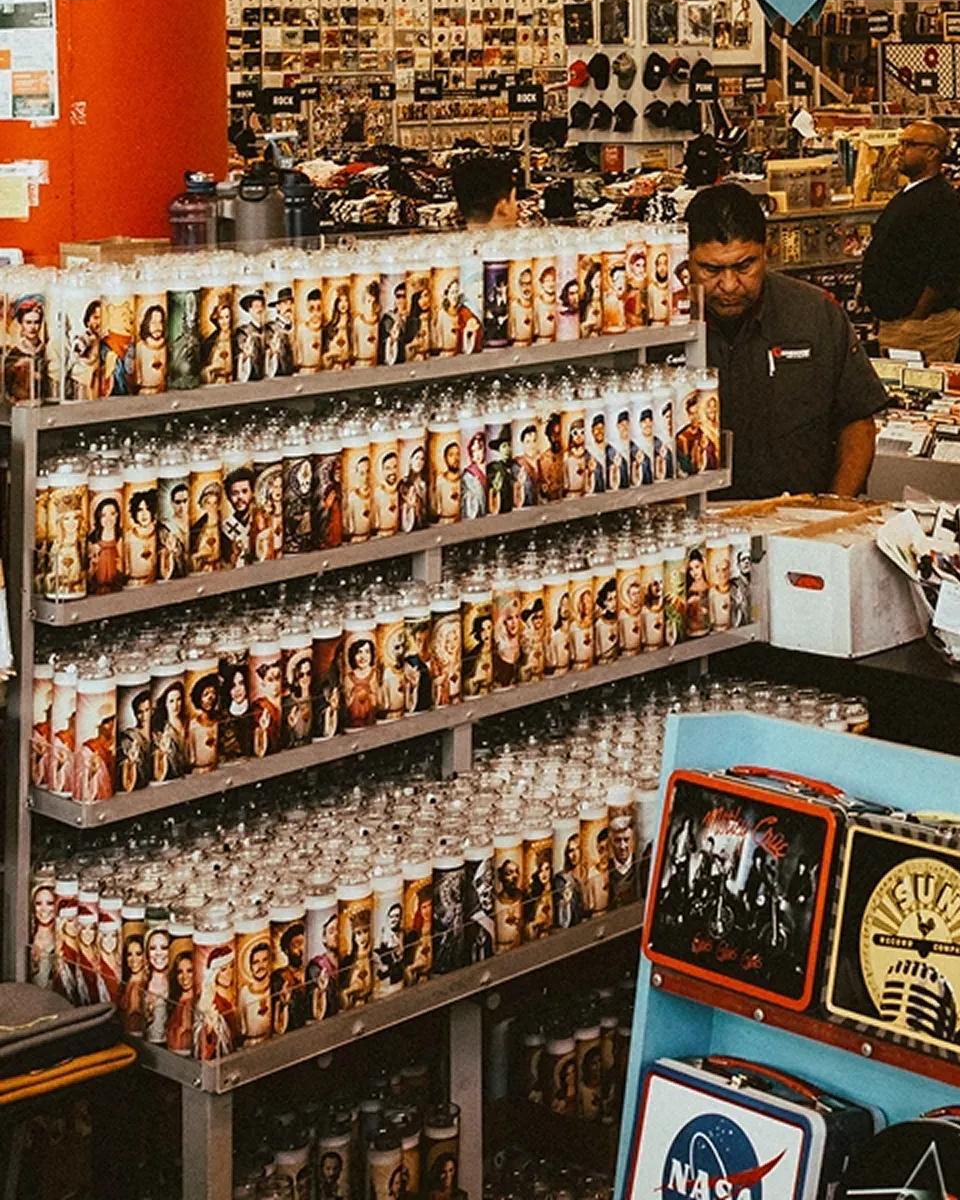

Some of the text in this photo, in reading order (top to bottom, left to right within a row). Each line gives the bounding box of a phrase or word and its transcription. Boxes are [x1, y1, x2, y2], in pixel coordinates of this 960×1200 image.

[272, 95, 295, 106] ROCK
[516, 92, 538, 104] ROCK
[878, 935, 914, 948] RECORD
